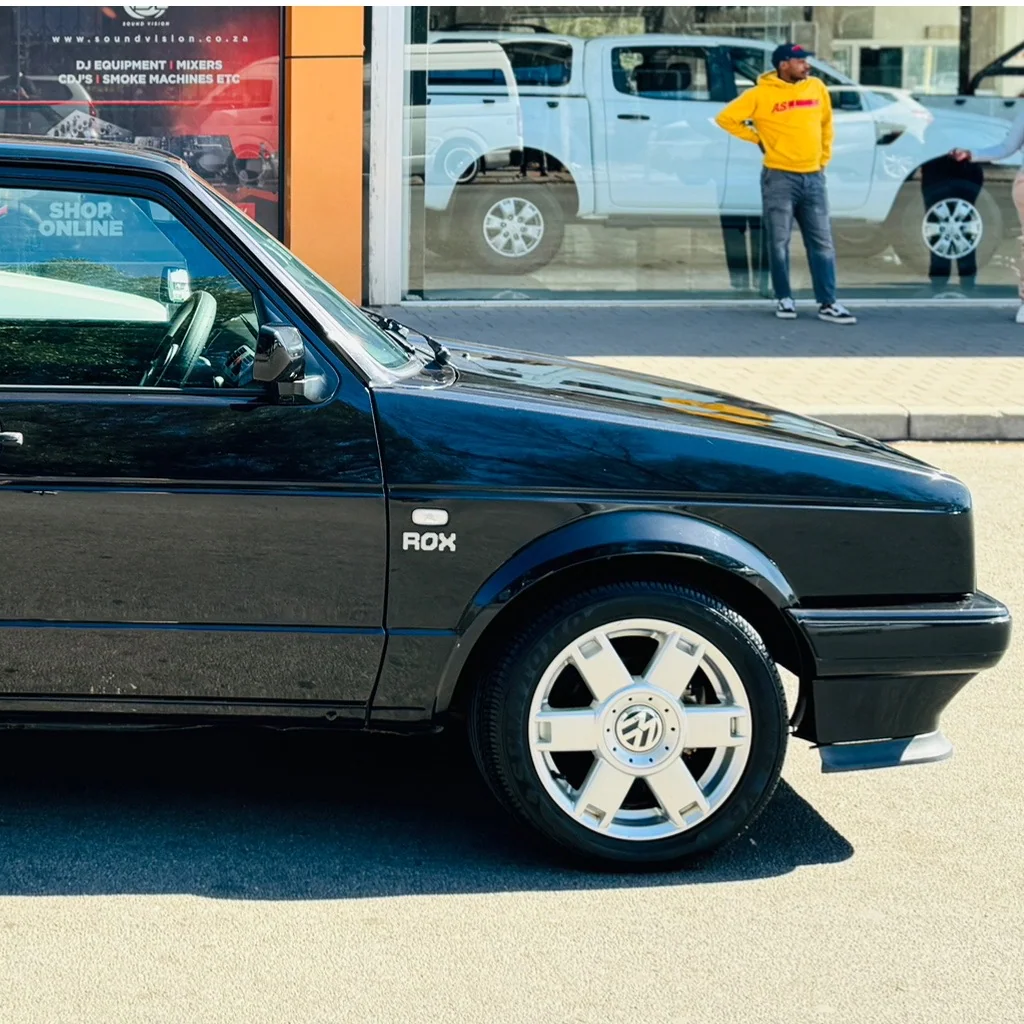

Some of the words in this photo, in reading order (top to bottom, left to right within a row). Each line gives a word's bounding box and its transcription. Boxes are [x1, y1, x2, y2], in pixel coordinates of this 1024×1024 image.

[76, 60, 91, 71] DJ
[94, 60, 167, 71] EQUIPMENT
[176, 60, 223, 71] MIXERS
[58, 74, 93, 85] CDJ'S
[102, 74, 146, 85] SMOKE
[149, 74, 214, 85] MACHINES
[216, 74, 241, 85] ETC
[49, 202, 113, 219] SHOP
[38, 220, 123, 237] ONLINE
[402, 532, 456, 552] ROX
